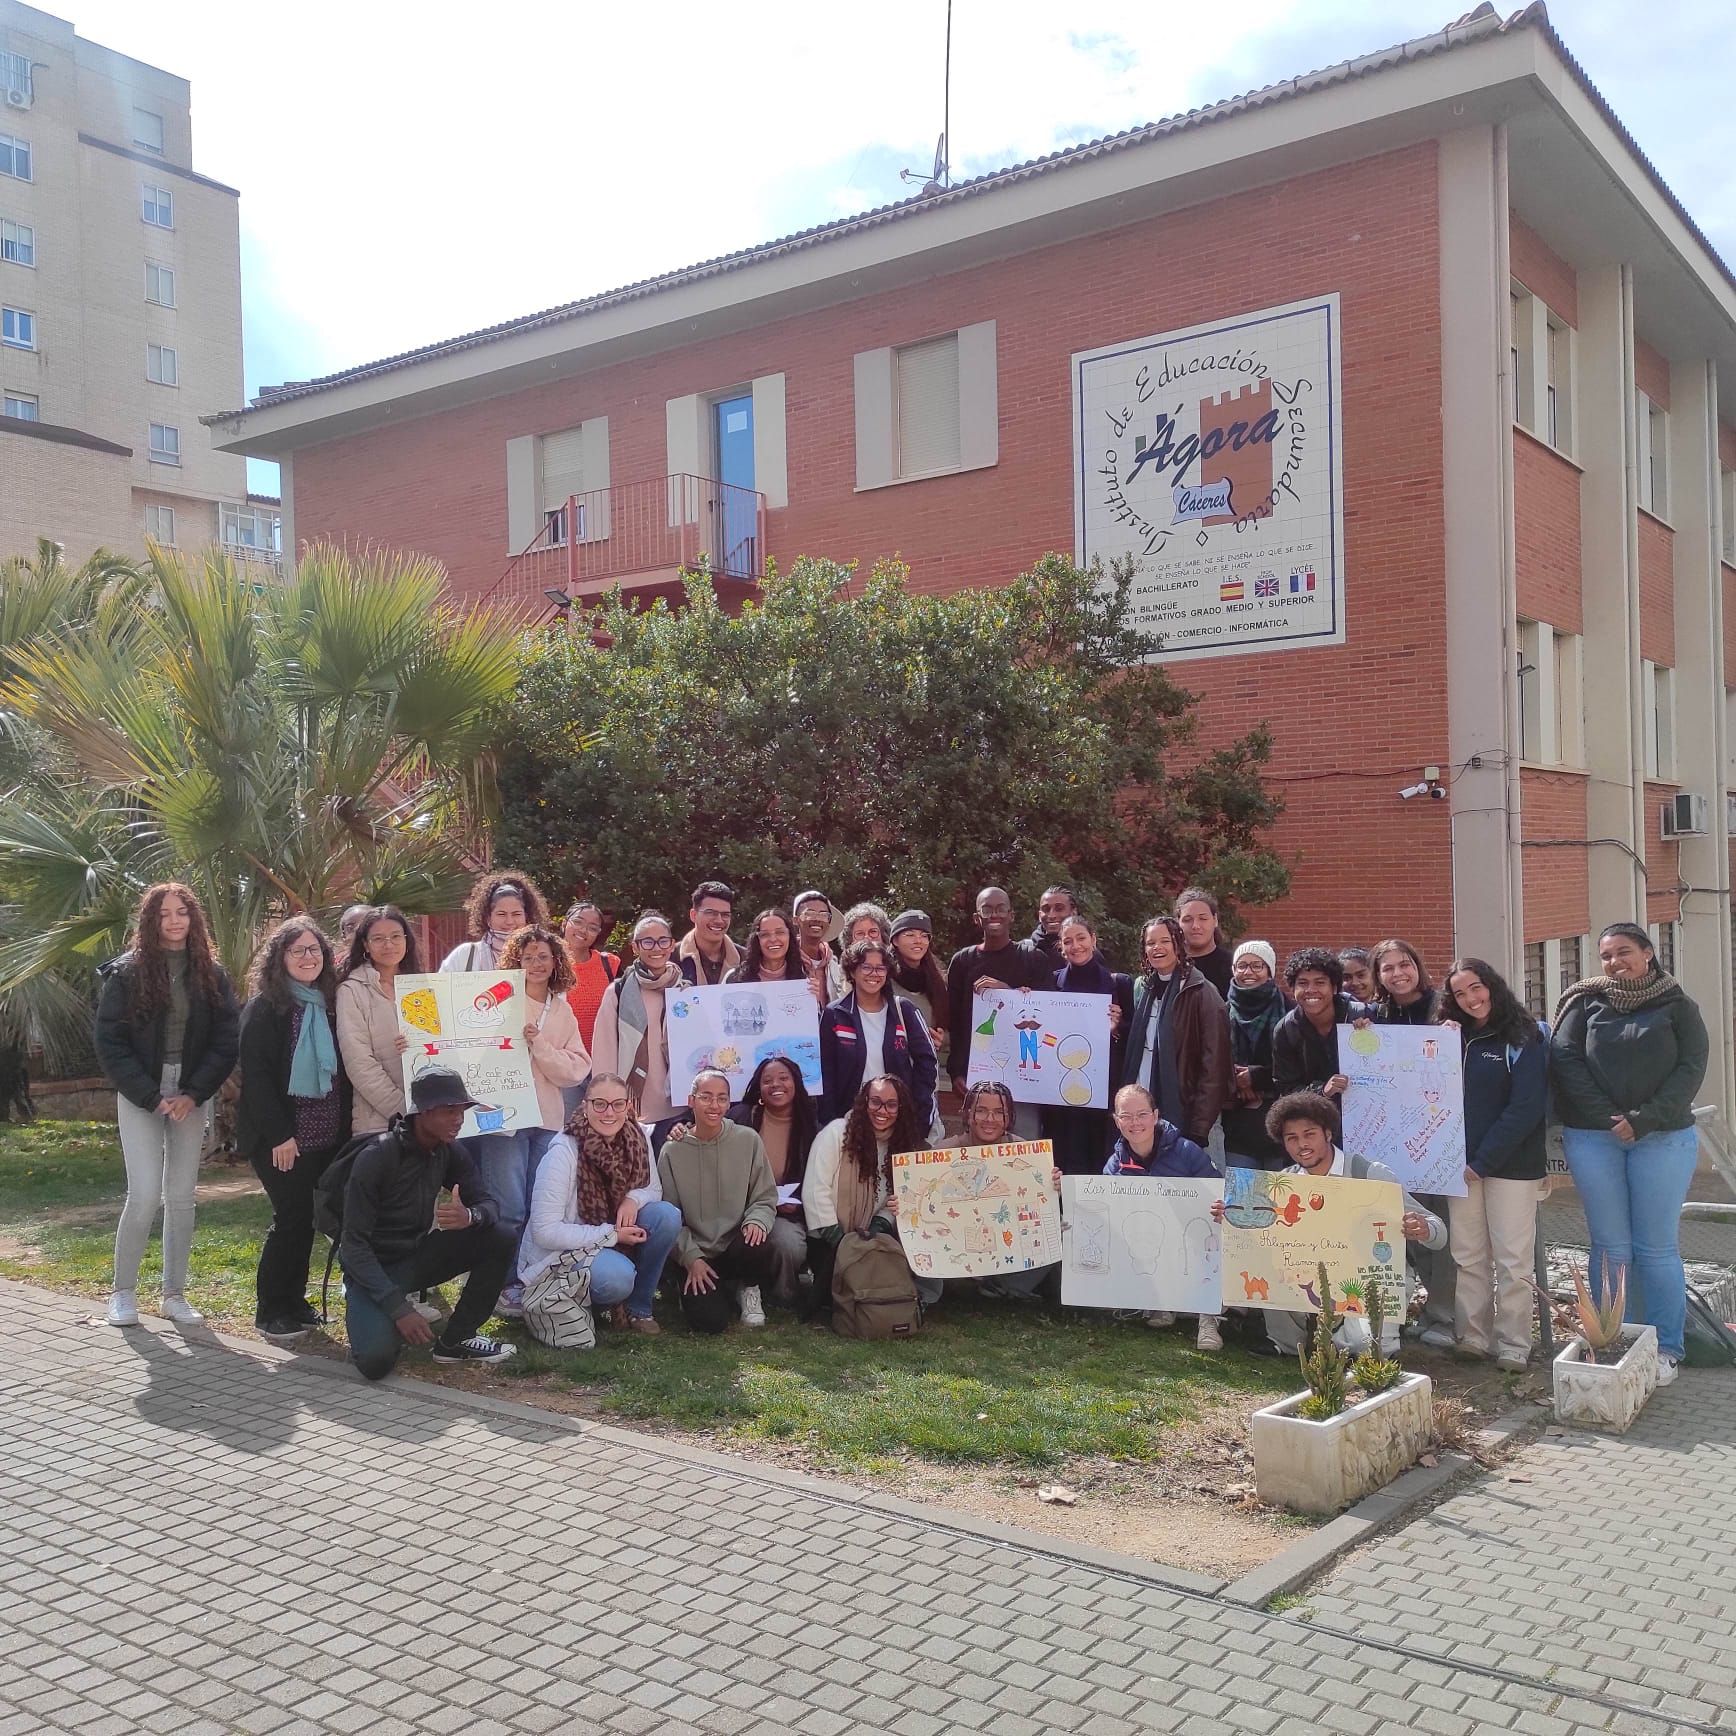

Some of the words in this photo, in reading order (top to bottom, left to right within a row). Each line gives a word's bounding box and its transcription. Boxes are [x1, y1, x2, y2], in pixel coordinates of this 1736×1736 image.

[1136, 349, 1268, 403] Educación
[1105, 407, 1134, 438] de
[1125, 403, 1285, 489] Ágora
[1233, 379, 1313, 534] Secundaria
[1098, 449, 1175, 555] Instituto
[1178, 491, 1226, 514] Cáceres
[1158, 562, 1171, 572] QUE
[1174, 561, 1182, 569] SE
[1185, 558, 1200, 568] SABE
[1216, 554, 1224, 563] SE
[1227, 551, 1253, 562] ENSEÑA
[1256, 549, 1264, 558] LO
[1268, 548, 1281, 556] QUE
[1285, 545, 1294, 554] SE
[1204, 565, 1218, 574] QUE
[1291, 563, 1314, 574] LYCÉE
[1136, 580, 1199, 595] BACHILLERATO
[1134, 610, 1187, 624] FORMATIVOS
[1190, 606, 1222, 617] GRADO
[1226, 602, 1254, 613] MEDIO
[1268, 595, 1315, 608] SUPERIOR
[1140, 601, 1178, 613] BILINGÜE
[1177, 627, 1222, 638] COMERCIO
[1229, 619, 1289, 633] INFORMÁTICA
[893, 1155, 911, 1167] LOS
[916, 1151, 953, 1165] LIBROS
[960, 1147, 969, 1161] &
[980, 1147, 994, 1158] LA
[998, 1141, 1052, 1157] ESCRITURA
[1083, 1178, 1106, 1195] Las
